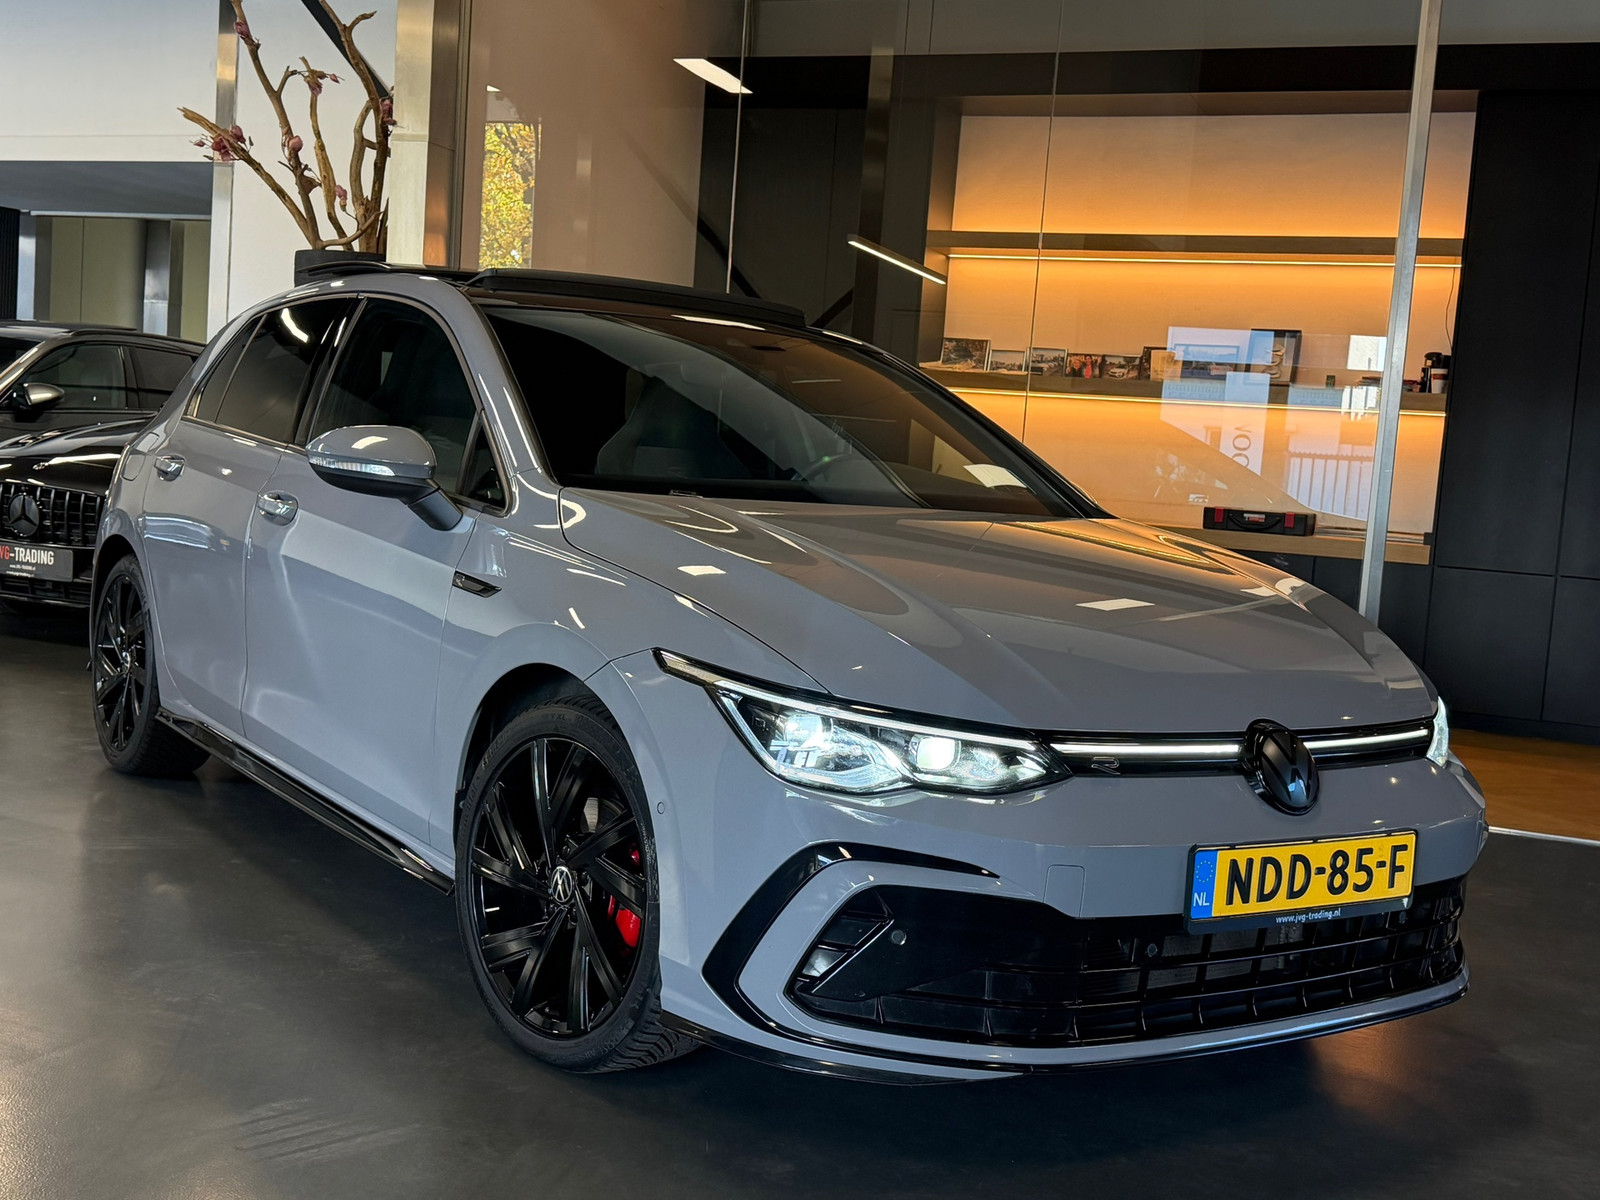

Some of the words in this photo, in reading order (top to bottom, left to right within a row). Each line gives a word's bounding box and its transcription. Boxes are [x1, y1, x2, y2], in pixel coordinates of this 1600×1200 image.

[1226, 844, 1408, 905] NDD-85-F
[1193, 892, 1210, 907] NL
[1275, 908, 1341, 924] www.jvg-trading.nl
